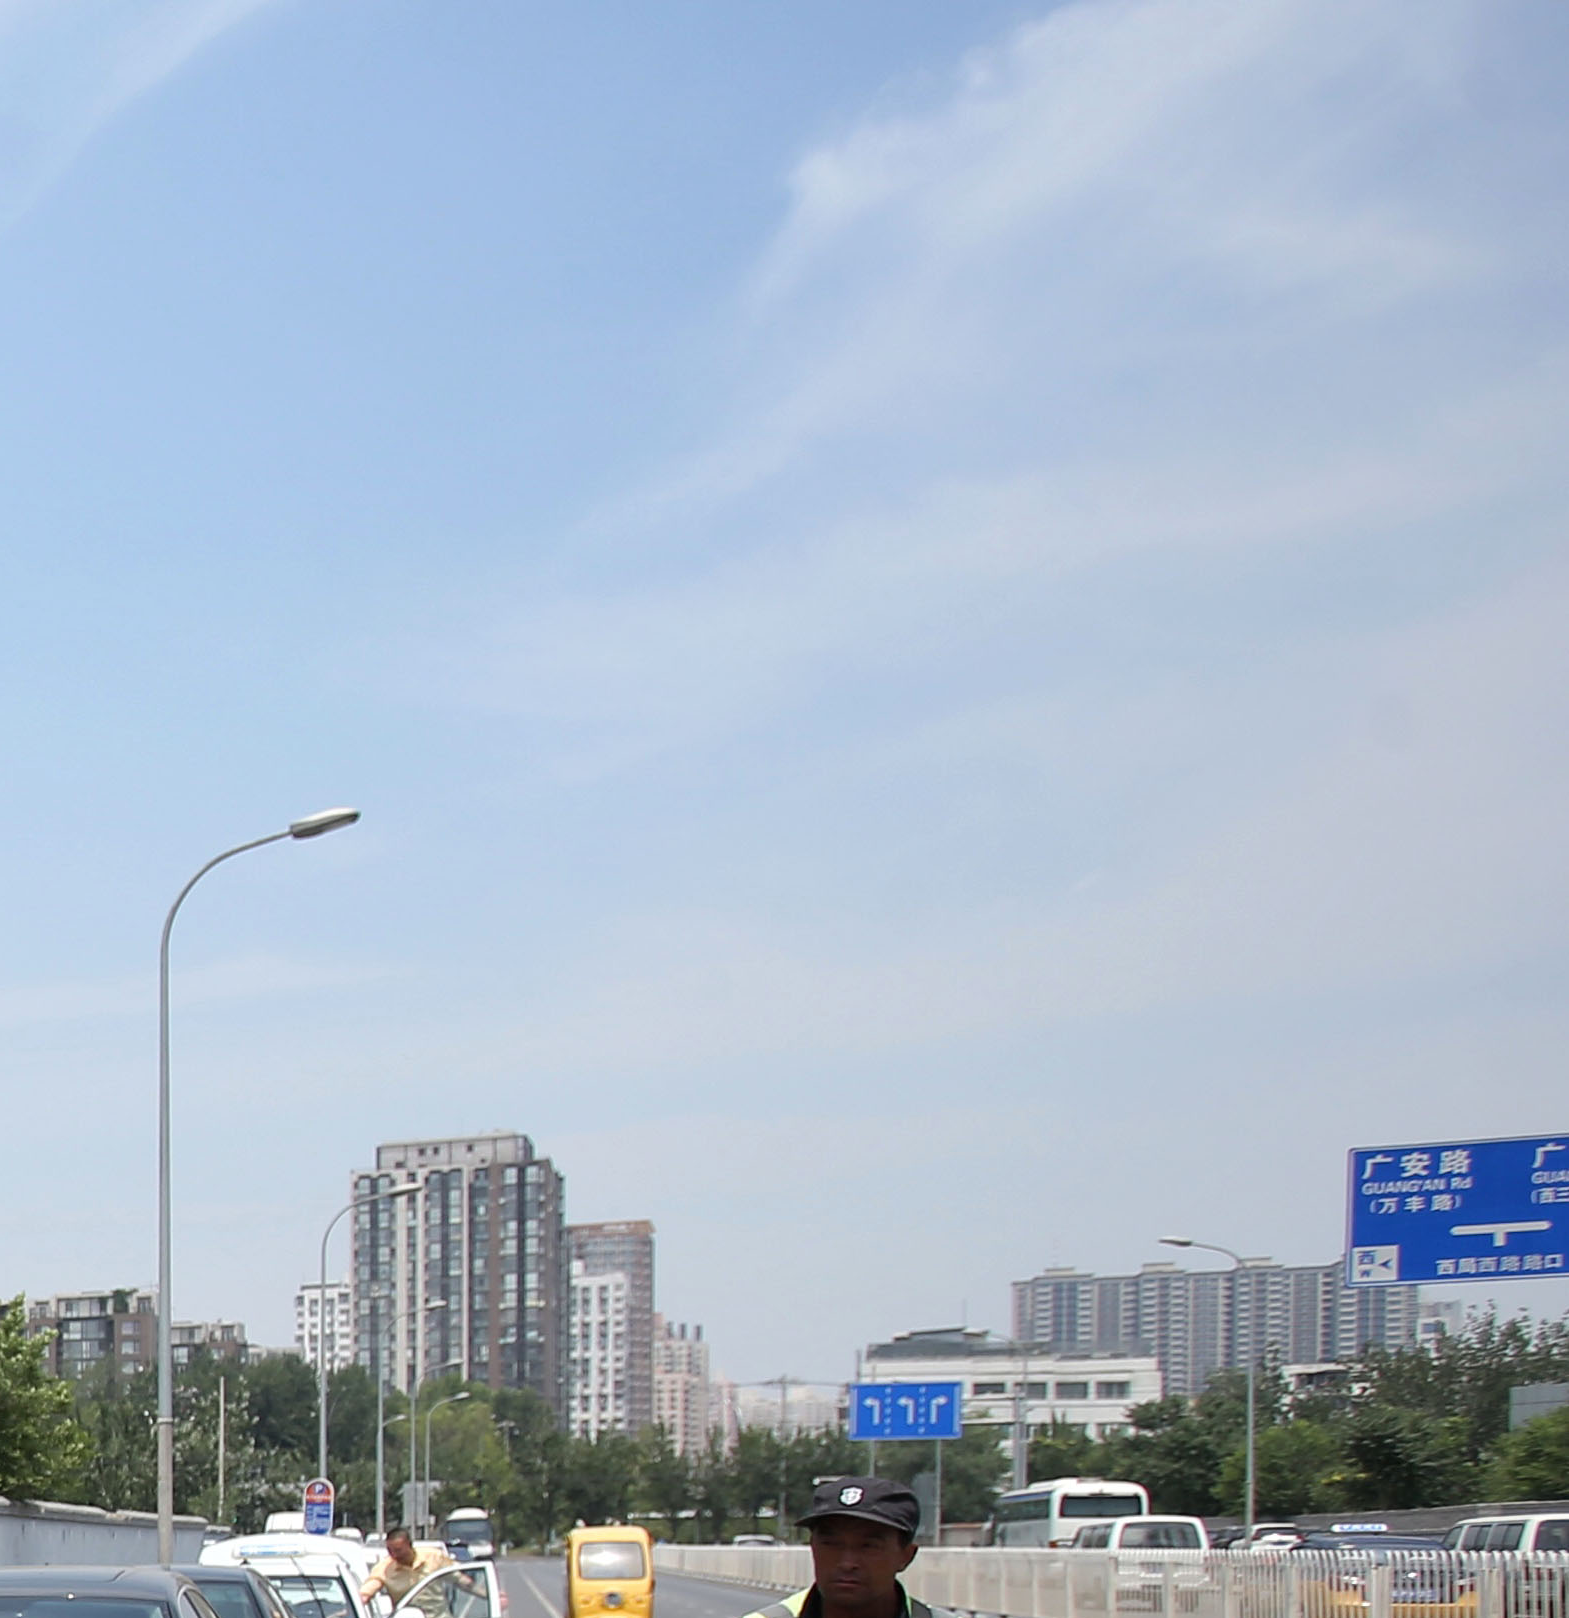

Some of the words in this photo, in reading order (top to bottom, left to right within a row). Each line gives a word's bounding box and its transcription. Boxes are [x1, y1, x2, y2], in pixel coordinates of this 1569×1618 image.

[1361, 1148, 1472, 1179] 广安路
[1531, 1142, 1567, 1168] 广
[1450, 1175, 1473, 1190] Rd
